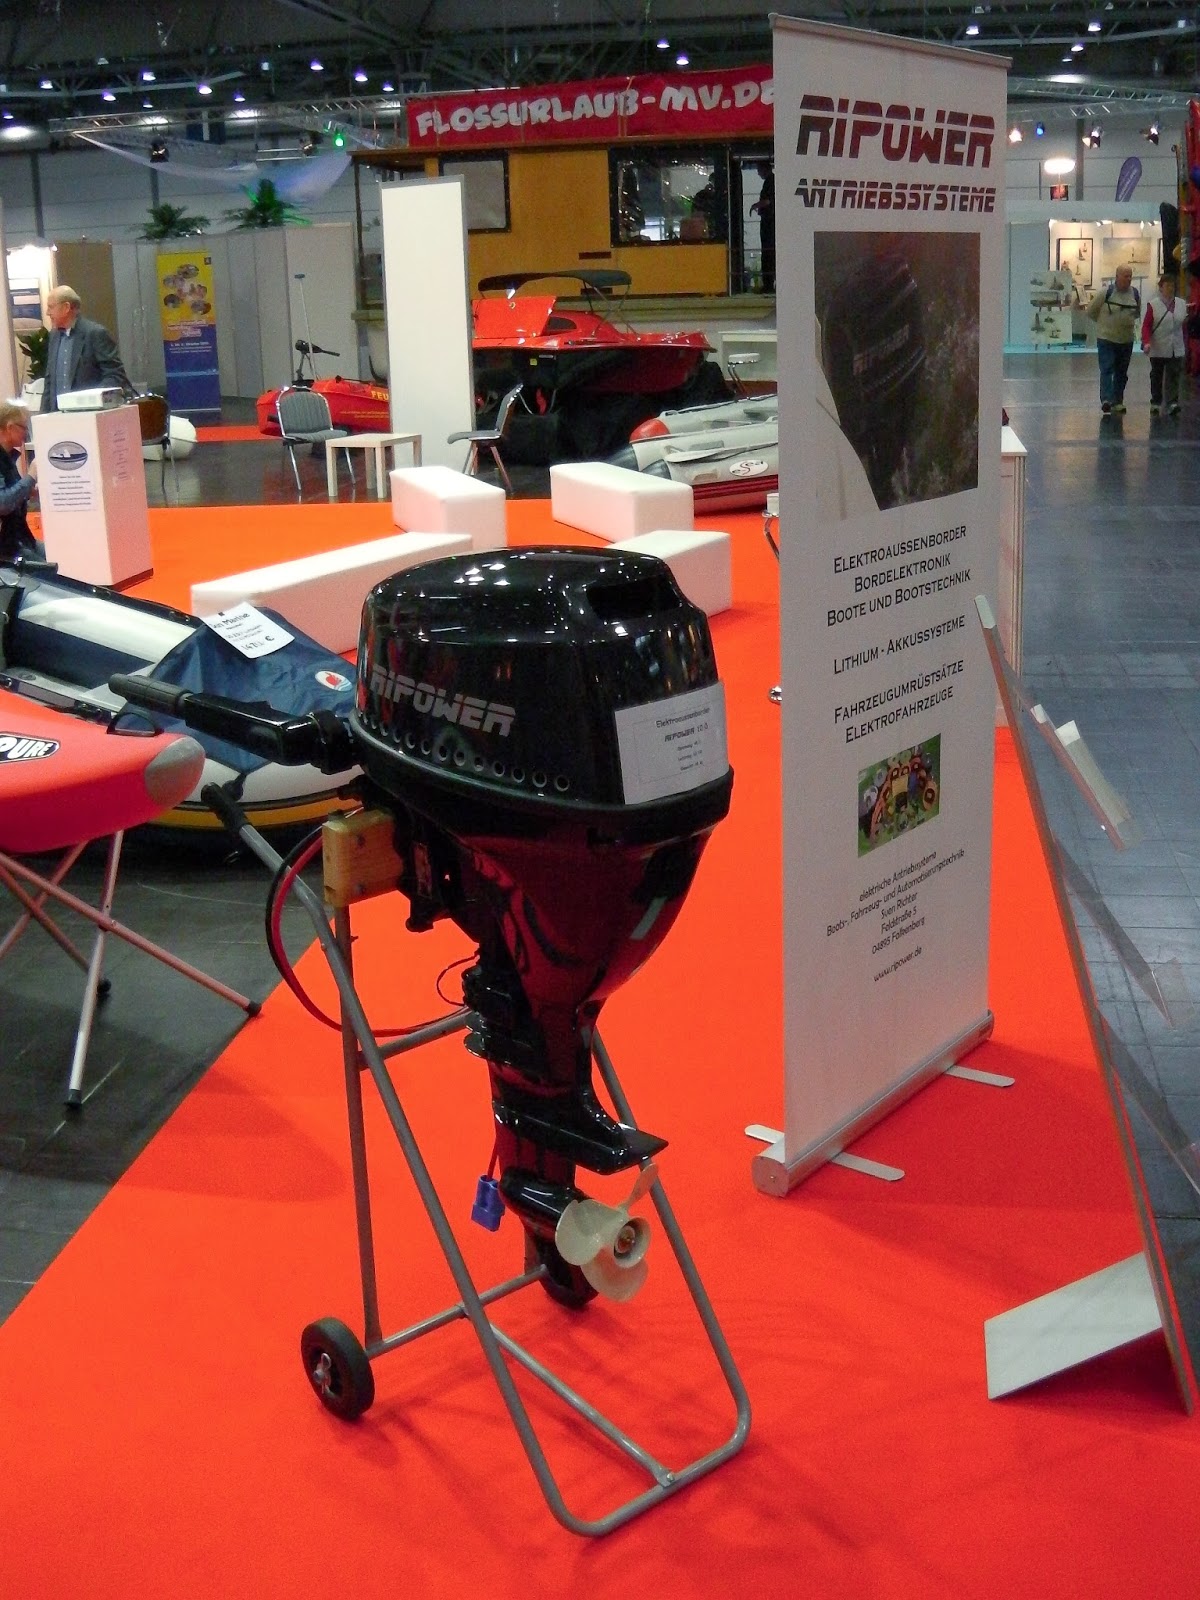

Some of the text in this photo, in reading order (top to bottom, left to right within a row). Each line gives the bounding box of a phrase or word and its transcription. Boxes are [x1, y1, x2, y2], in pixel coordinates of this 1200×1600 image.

[795, 94, 995, 169] RIPOWER
[794, 178, 996, 213] ANTRIEBSSYSTEME
[833, 525, 967, 574] ELEKTROAUSSENBORDER
[854, 552, 951, 593] BORDELEKTRONIK
[827, 568, 971, 627] BOOTE UND BOOTSTECHNIK
[834, 646, 879, 675] LITHIUM
[886, 614, 965, 655] AKKUSSYSTEME
[370, 663, 516, 737] RIPOWER
[834, 659, 964, 724] FAHRZEUGUMRÜSTSÄTZE
[664, 727, 695, 742] RIPOWER
[845, 686, 954, 744] ELEKTROFAHRZEUGE
[859, 877, 892, 902] elektrische
[880, 892, 918, 920] Sven Richter
[883, 889, 896, 903] und
[891, 916, 925, 943] Falkenberg
[873, 945, 922, 982] www.ripower.de
